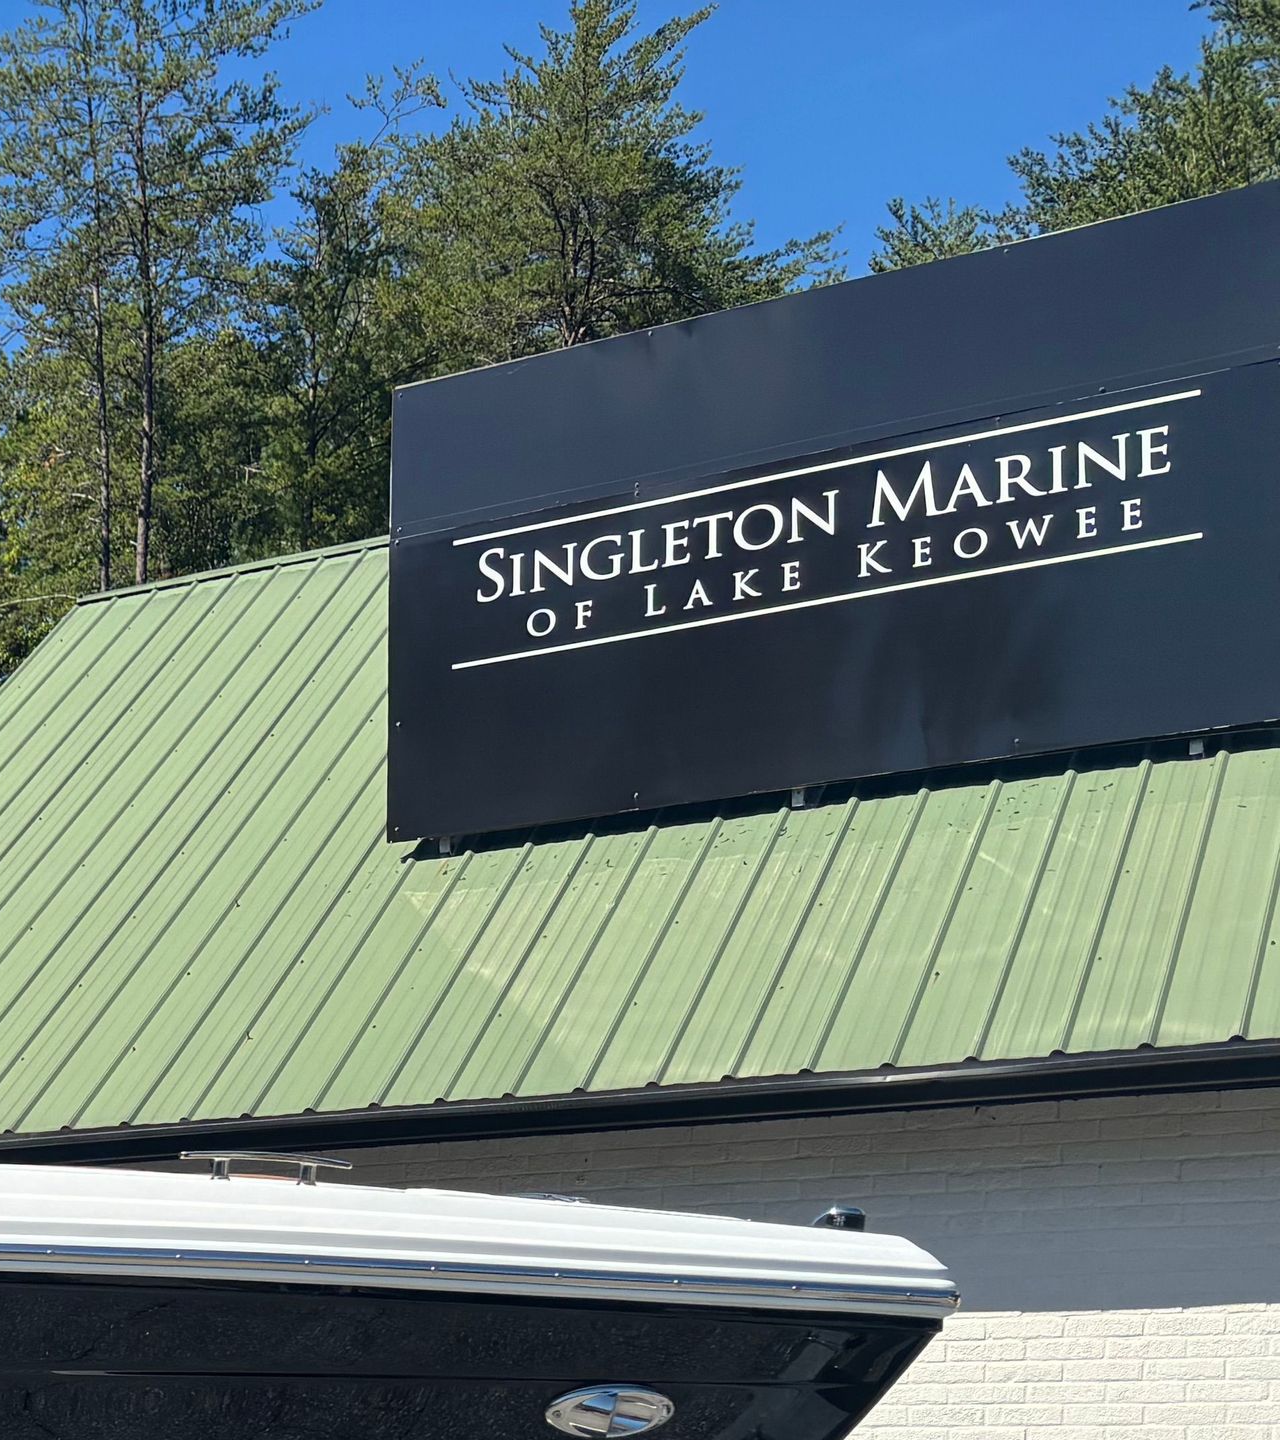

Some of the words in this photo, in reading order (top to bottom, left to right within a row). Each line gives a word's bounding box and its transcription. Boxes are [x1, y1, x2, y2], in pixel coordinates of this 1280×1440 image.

[476, 490, 840, 604] SINGLETON
[866, 424, 1172, 529] MARINE
[526, 600, 593, 638] OF
[643, 560, 802, 617] LAKE
[856, 498, 1143, 579] KEOWEE
